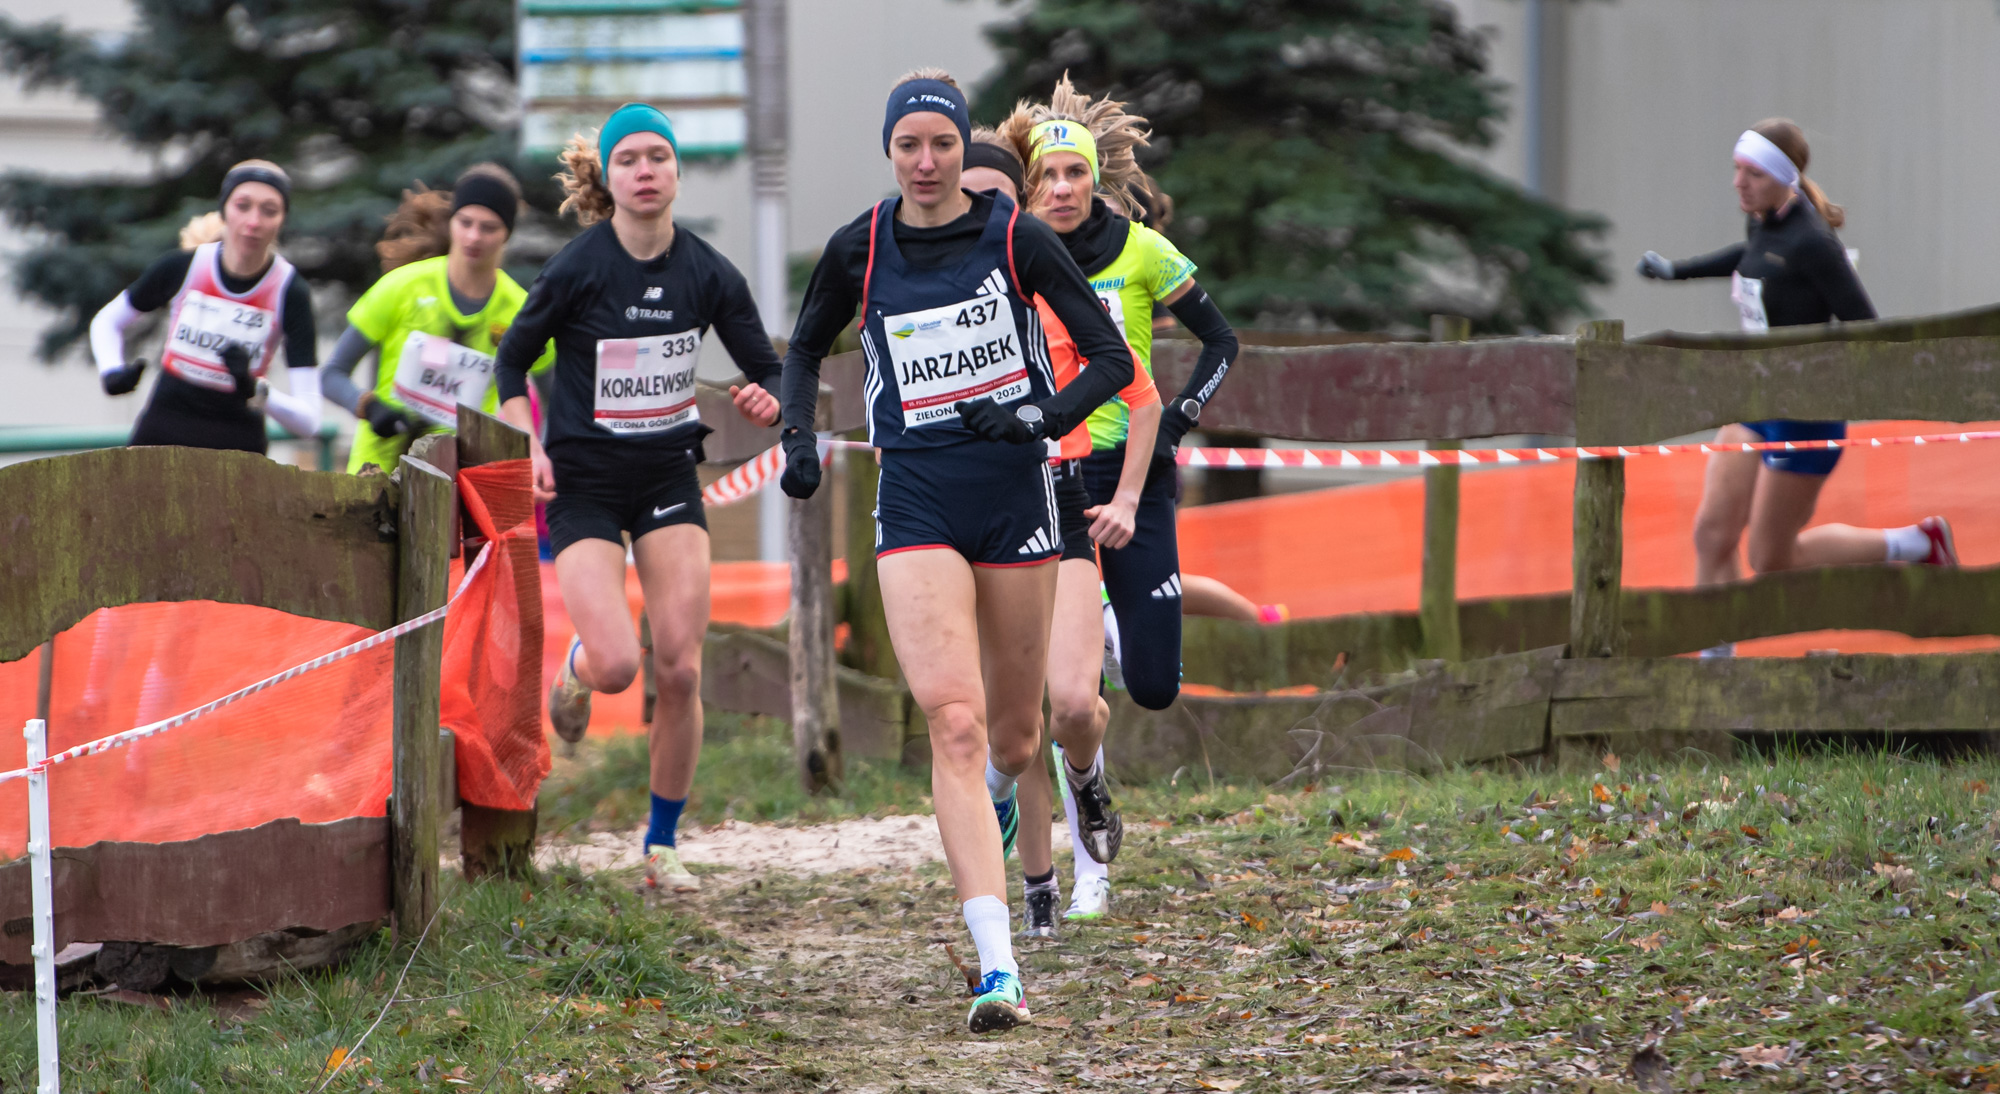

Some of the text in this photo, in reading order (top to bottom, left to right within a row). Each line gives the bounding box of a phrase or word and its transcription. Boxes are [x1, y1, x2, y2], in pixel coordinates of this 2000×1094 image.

[920, 94, 956, 111] TERREX
[639, 308, 673, 320] TRADE
[955, 298, 999, 329] 437
[662, 335, 695, 358] 333
[902, 333, 1017, 386] JARZĄBEK
[601, 367, 695, 398] KORALEWSKA
[1197, 357, 1229, 402] TERREX
[995, 384, 1022, 400] 2023
[608, 421, 646, 429] IELONA
